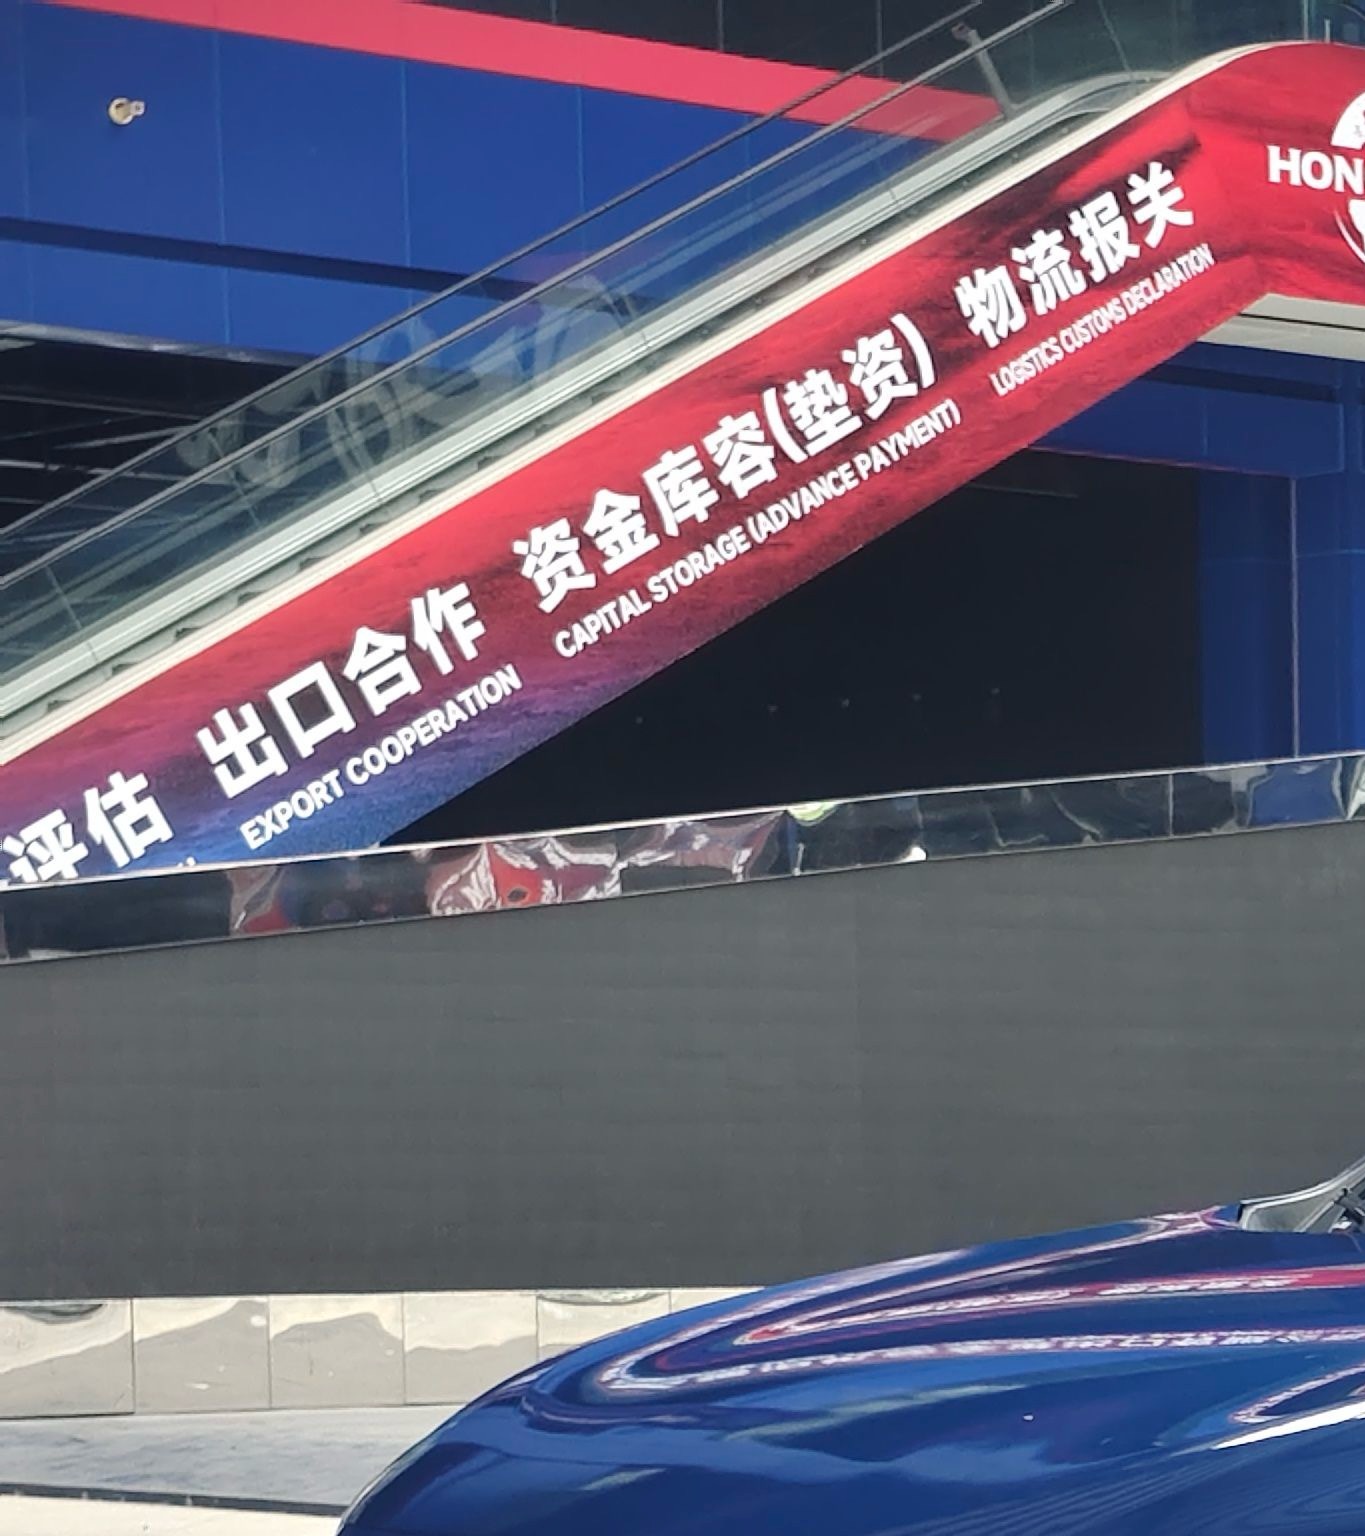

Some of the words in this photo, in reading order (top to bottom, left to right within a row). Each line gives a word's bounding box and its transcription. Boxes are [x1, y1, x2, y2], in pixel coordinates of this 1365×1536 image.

[2, 771, 175, 885] 评估
[196, 582, 487, 799] 出口合作
[953, 161, 1195, 349] 物流报关
[239, 769, 346, 850] EXPORT
[345, 663, 524, 785] COOPERATION
[554, 589, 653, 659] CAPITAL
[647, 525, 752, 604] STORAGE
[746, 461, 861, 545] (ADVANCE
[852, 398, 962, 482] PAYMENT)
[989, 336, 1066, 397] LOGISTICS
[1058, 297, 1128, 354] CUSTOMS
[1119, 243, 1216, 317] DECLARATION
